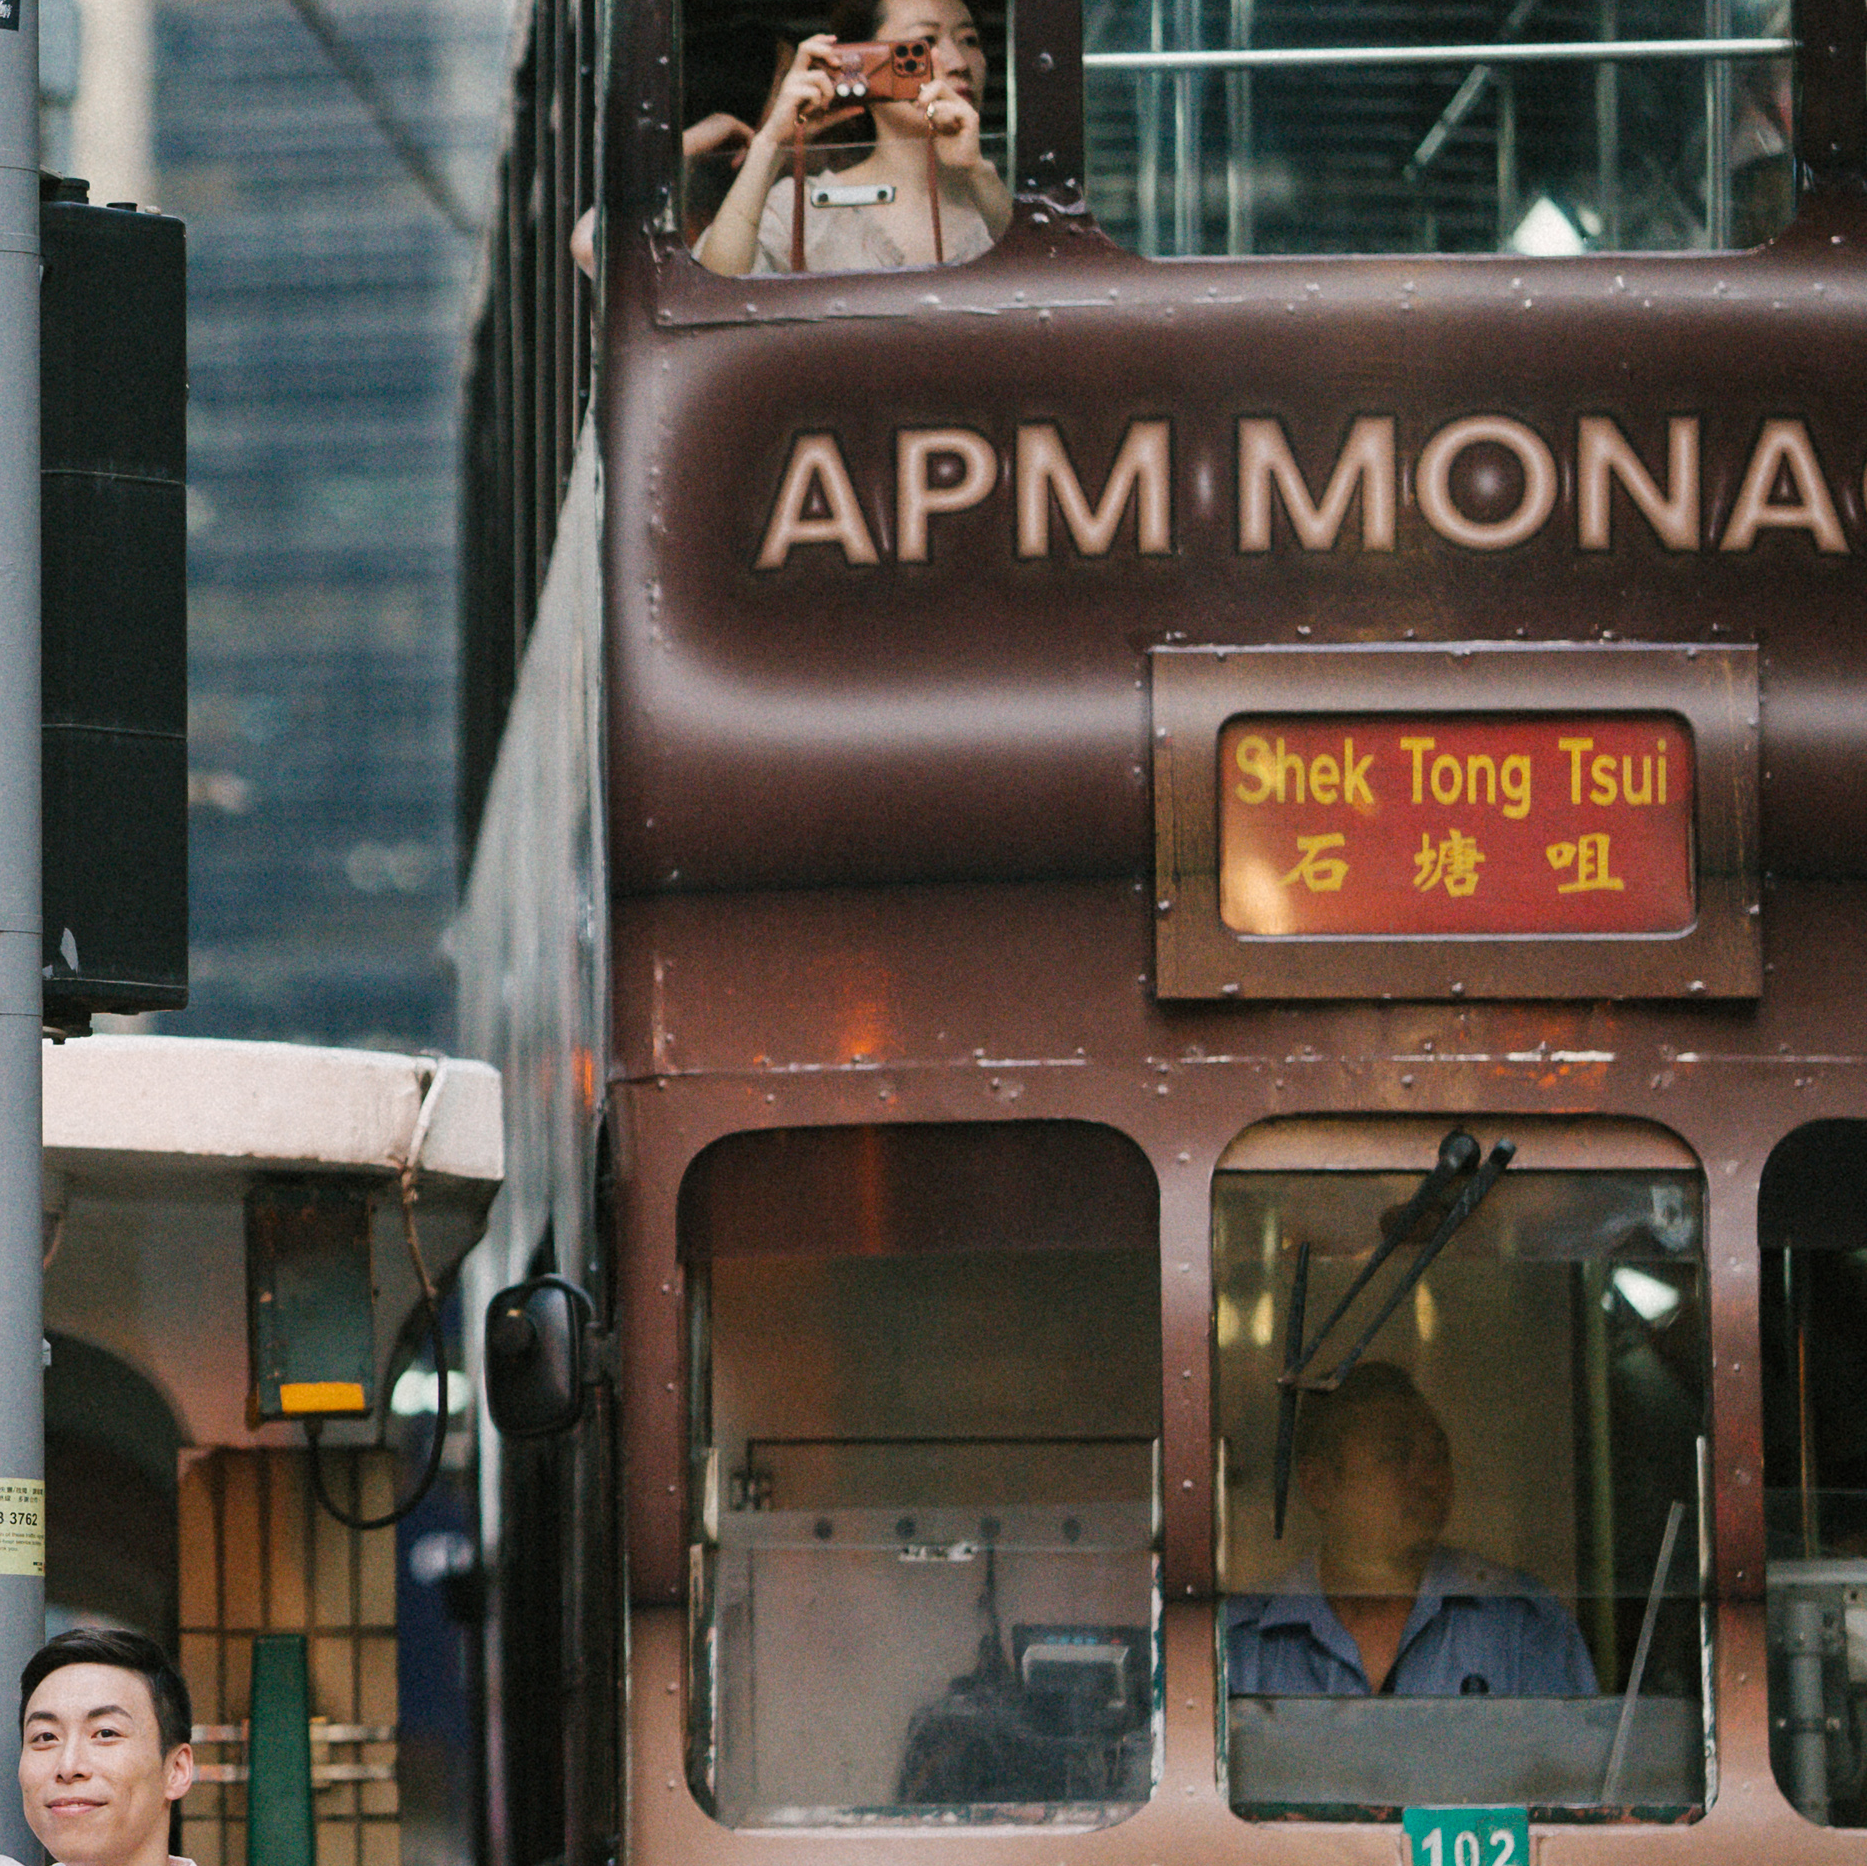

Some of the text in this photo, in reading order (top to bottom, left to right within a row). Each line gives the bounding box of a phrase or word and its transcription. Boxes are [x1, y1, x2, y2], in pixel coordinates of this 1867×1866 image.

[753, 414, 1867, 571] APM MONA
[1236, 735, 1668, 820] Shek Tong Tsui
[1278, 828, 1625, 898] 石塘咀
[9, 1511, 38, 1526] 3762
